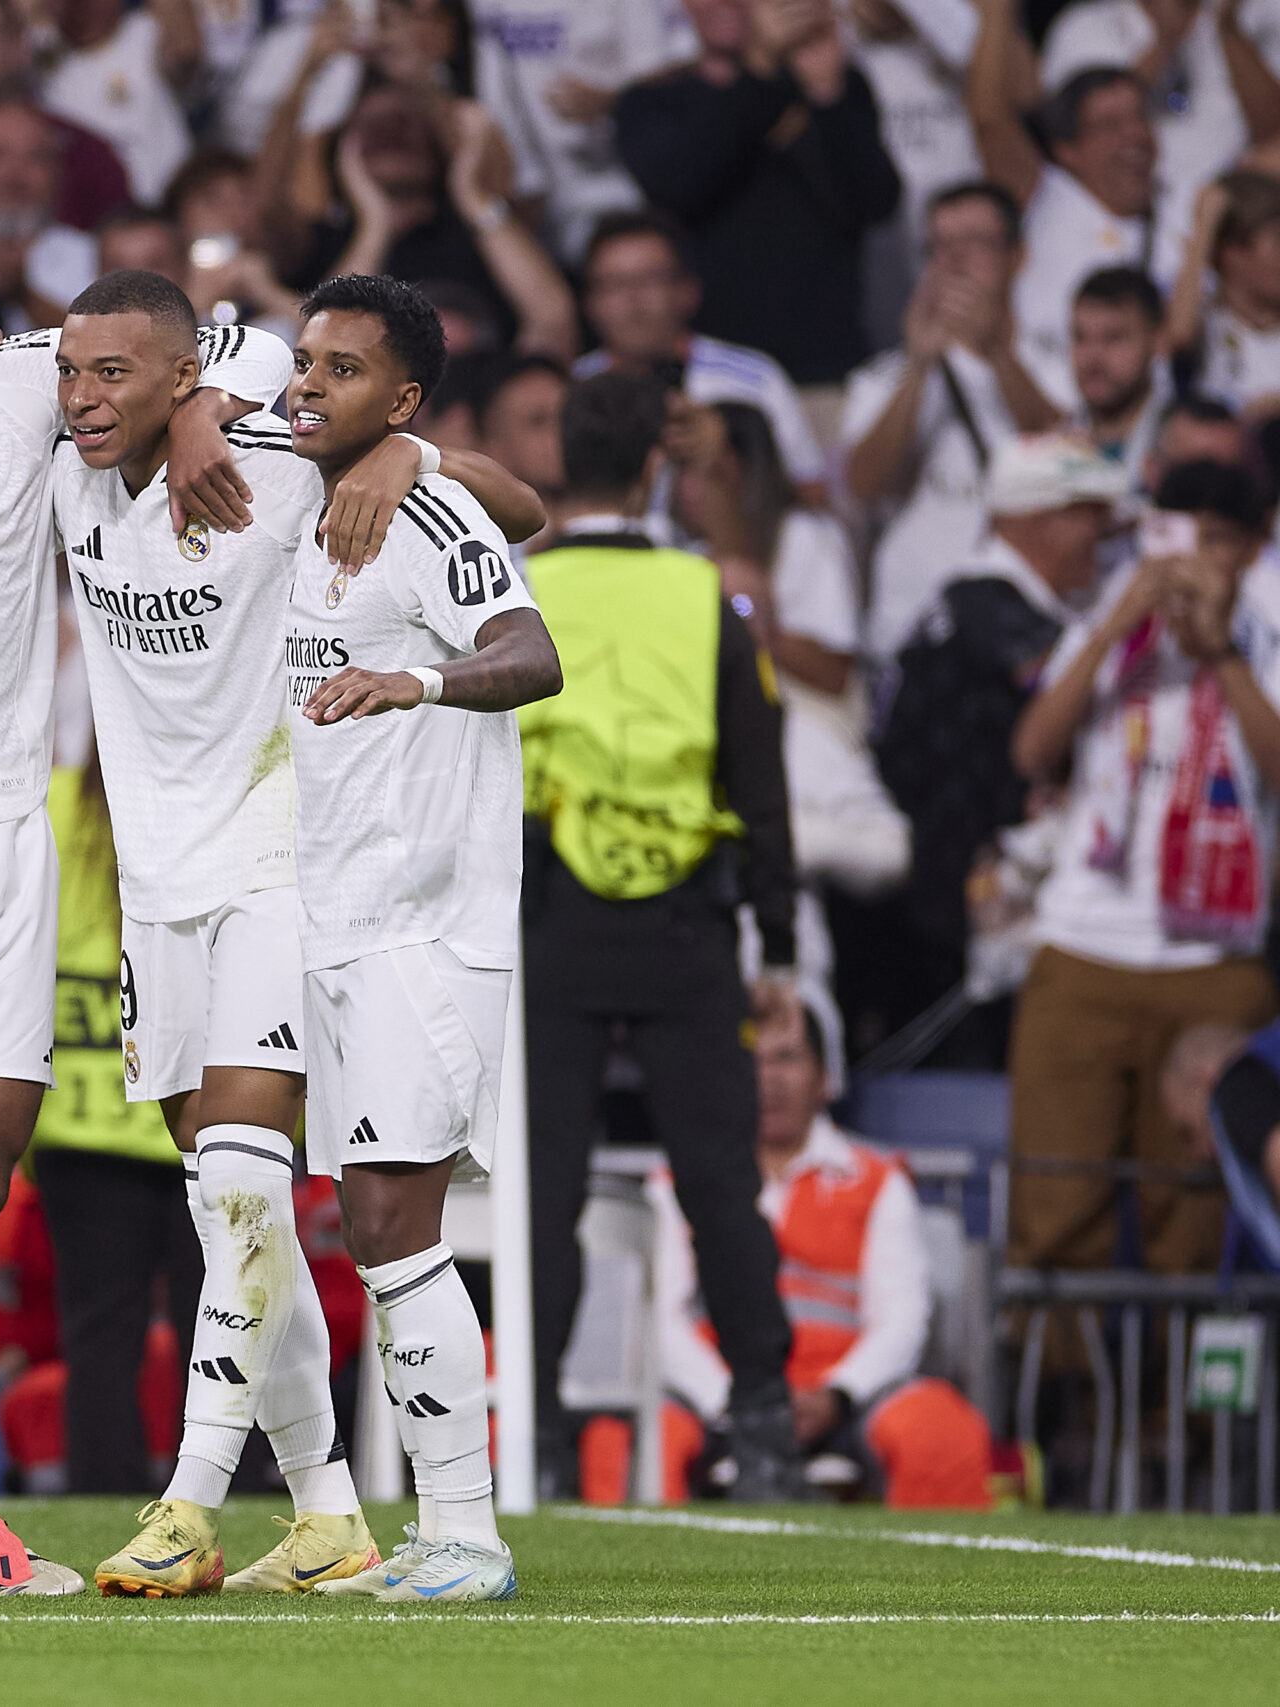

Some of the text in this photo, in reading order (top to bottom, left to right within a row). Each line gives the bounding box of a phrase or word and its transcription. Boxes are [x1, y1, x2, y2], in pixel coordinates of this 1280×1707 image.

[451, 541, 507, 605] hp
[77, 571, 223, 622] Emirates
[107, 618, 210, 655] FLY BETTER
[120, 949, 138, 1031] 9
[202, 1304, 263, 1331] RMCF
[393, 1346, 435, 1367] MCF
